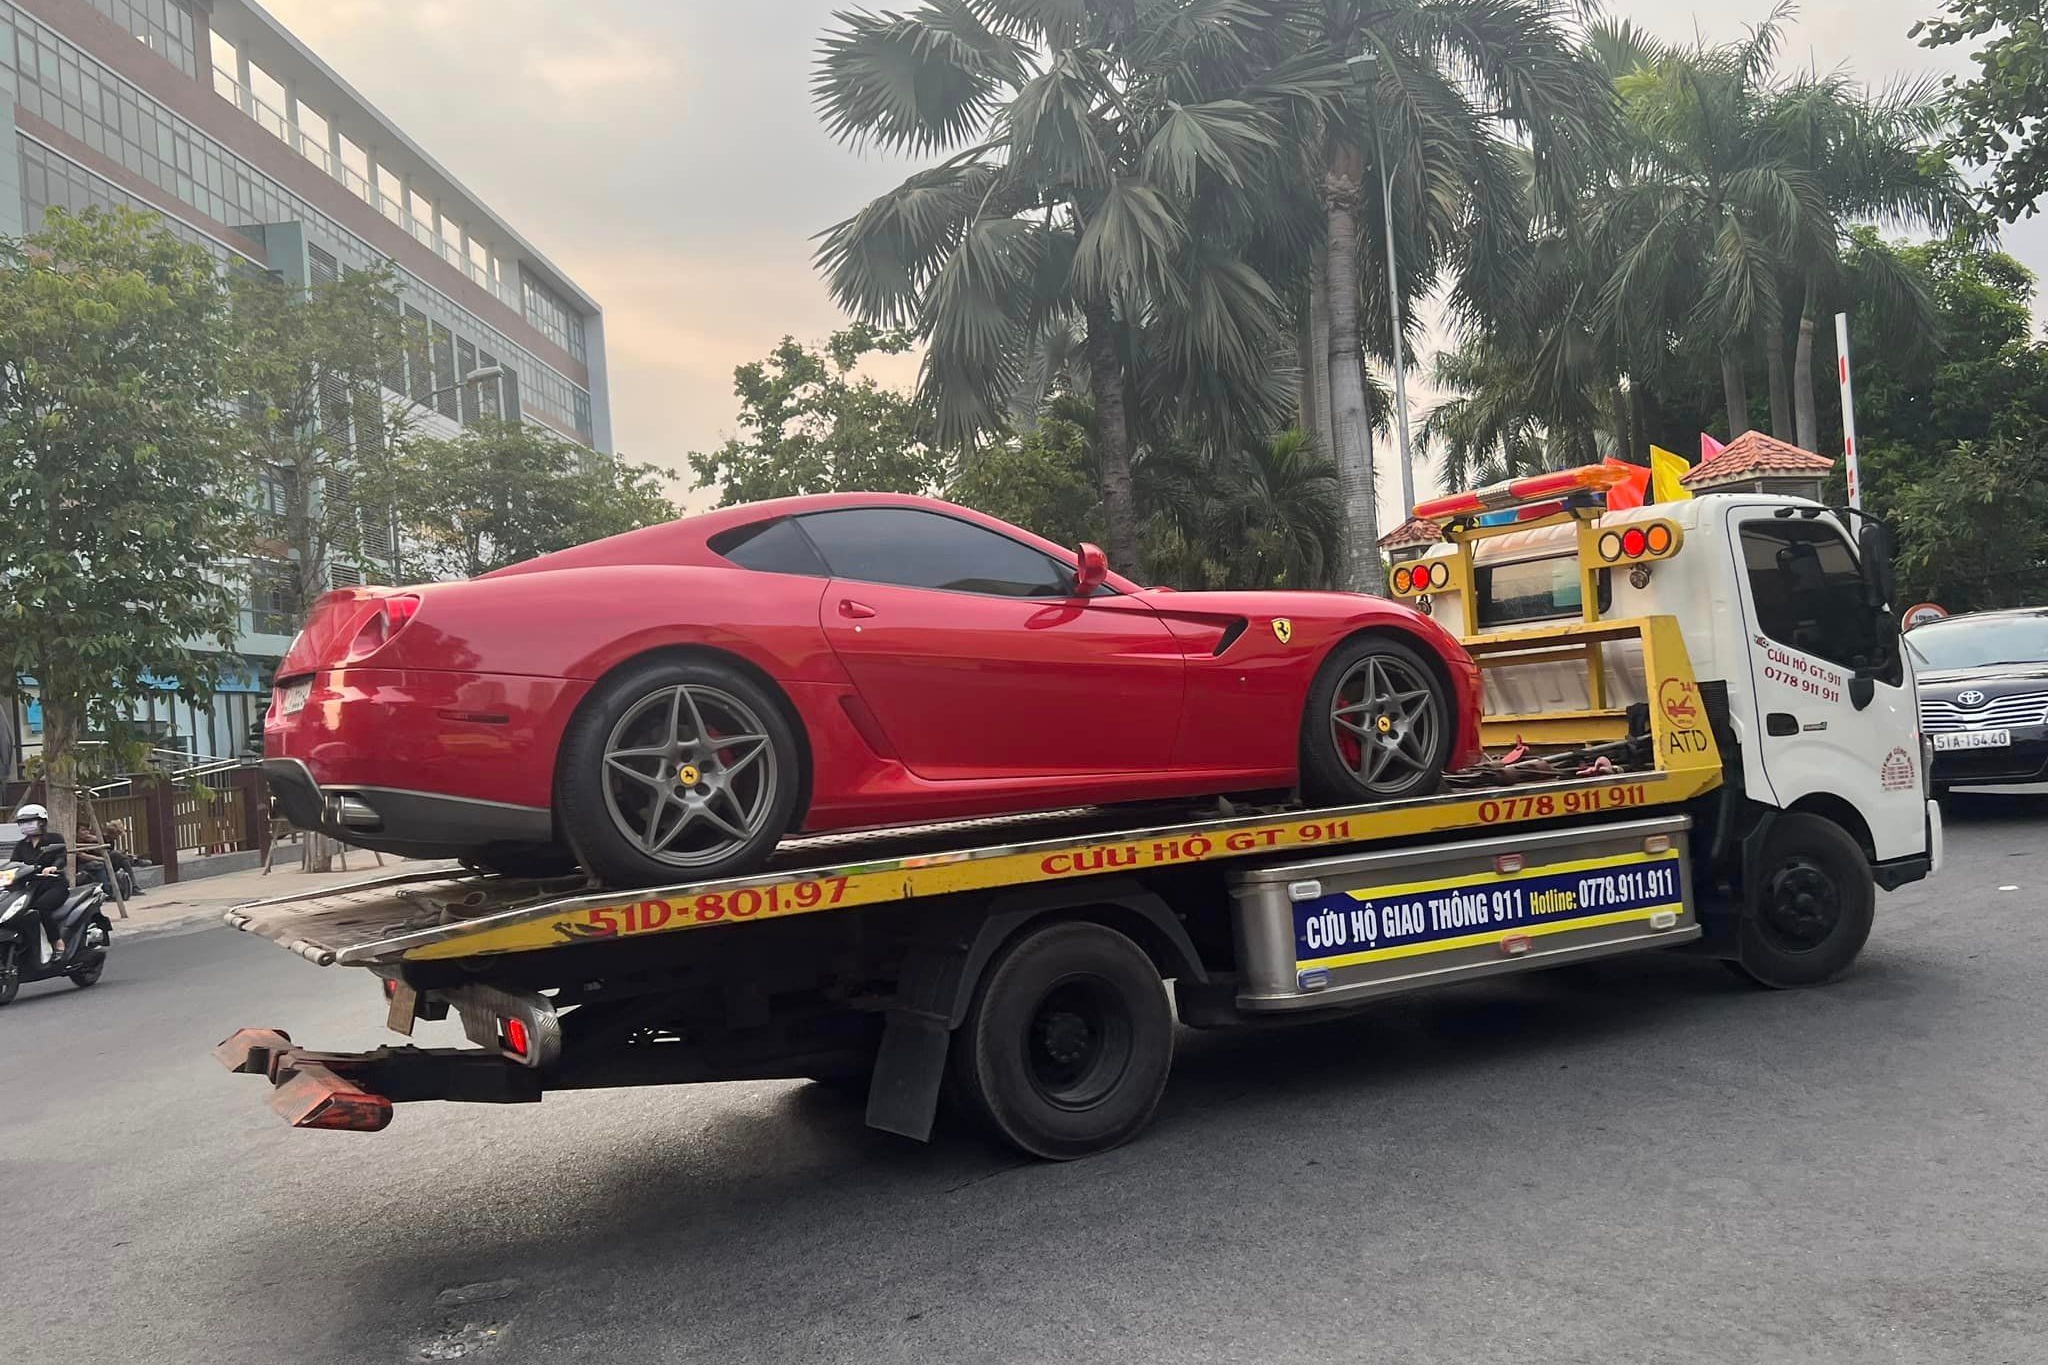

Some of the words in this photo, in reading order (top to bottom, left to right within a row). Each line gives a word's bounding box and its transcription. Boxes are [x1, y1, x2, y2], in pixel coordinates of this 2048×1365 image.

[1767, 647, 1790, 666] CỨU
[1793, 657, 1807, 674] HỘ
[1764, 667, 1798, 687] 0778
[1802, 680, 1819, 695] 911
[1822, 687, 1839, 703] 911
[1479, 796, 1554, 823] 0778
[1564, 789, 1601, 812] 911
[1609, 785, 1645, 807] 911
[1153, 832, 1212, 861] HỘ
[1225, 829, 1285, 850] GT
[1298, 820, 1349, 841] 911
[588, 877, 847, 936] 51D-801.97
[1306, 908, 1346, 949] CỨU
[1351, 903, 1377, 948] HỘ
[1382, 902, 1425, 938] GIAO
[1428, 891, 1489, 931] THÔNG
[1492, 889, 1523, 921] 911
[1530, 890, 1577, 916] Hotline:
[1579, 868, 1673, 908] 0778.911.911
